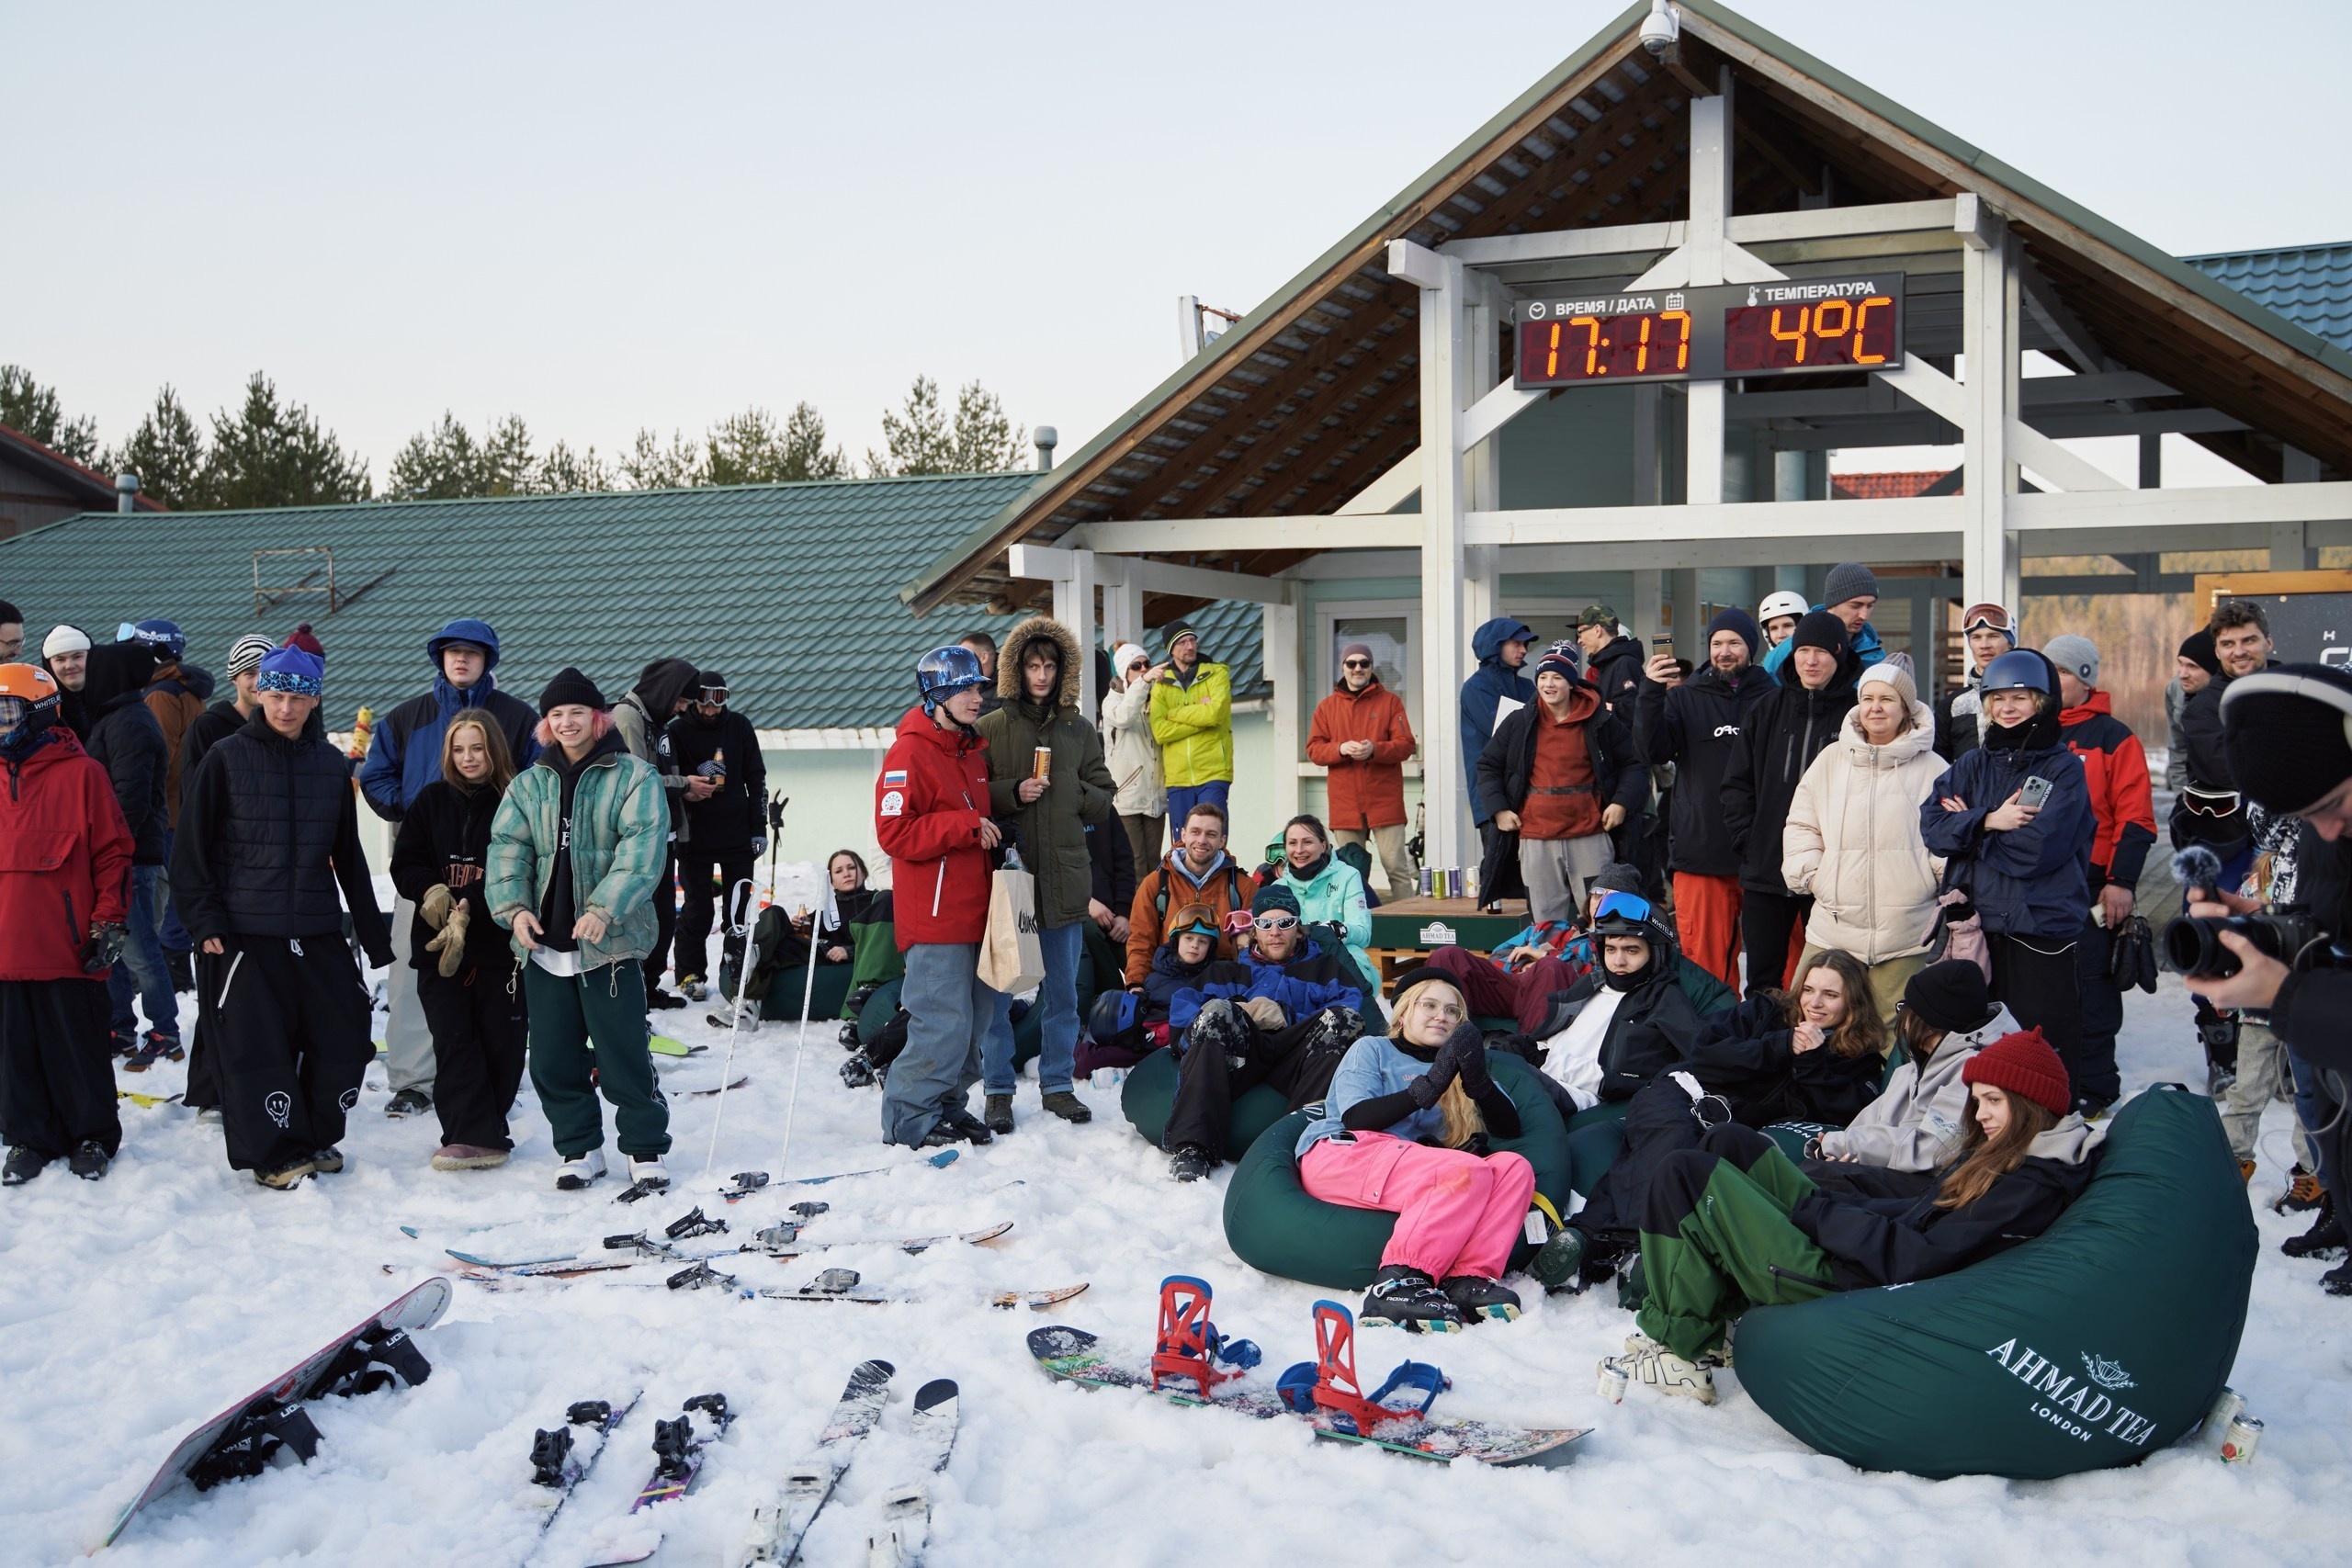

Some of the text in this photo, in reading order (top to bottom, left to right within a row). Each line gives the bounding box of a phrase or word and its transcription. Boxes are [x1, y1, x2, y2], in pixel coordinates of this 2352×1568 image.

[1555, 300, 1606, 316] ВРЕМЯ
[1616, 297, 1656, 313] ДАТА
[1765, 281, 1876, 301] ТЕМПЕРАТУРА
[1547, 310, 1691, 378] 17:17
[1985, 1337, 2157, 1446] AHMAD TEA
[2030, 1402, 2093, 1442] LONDON
